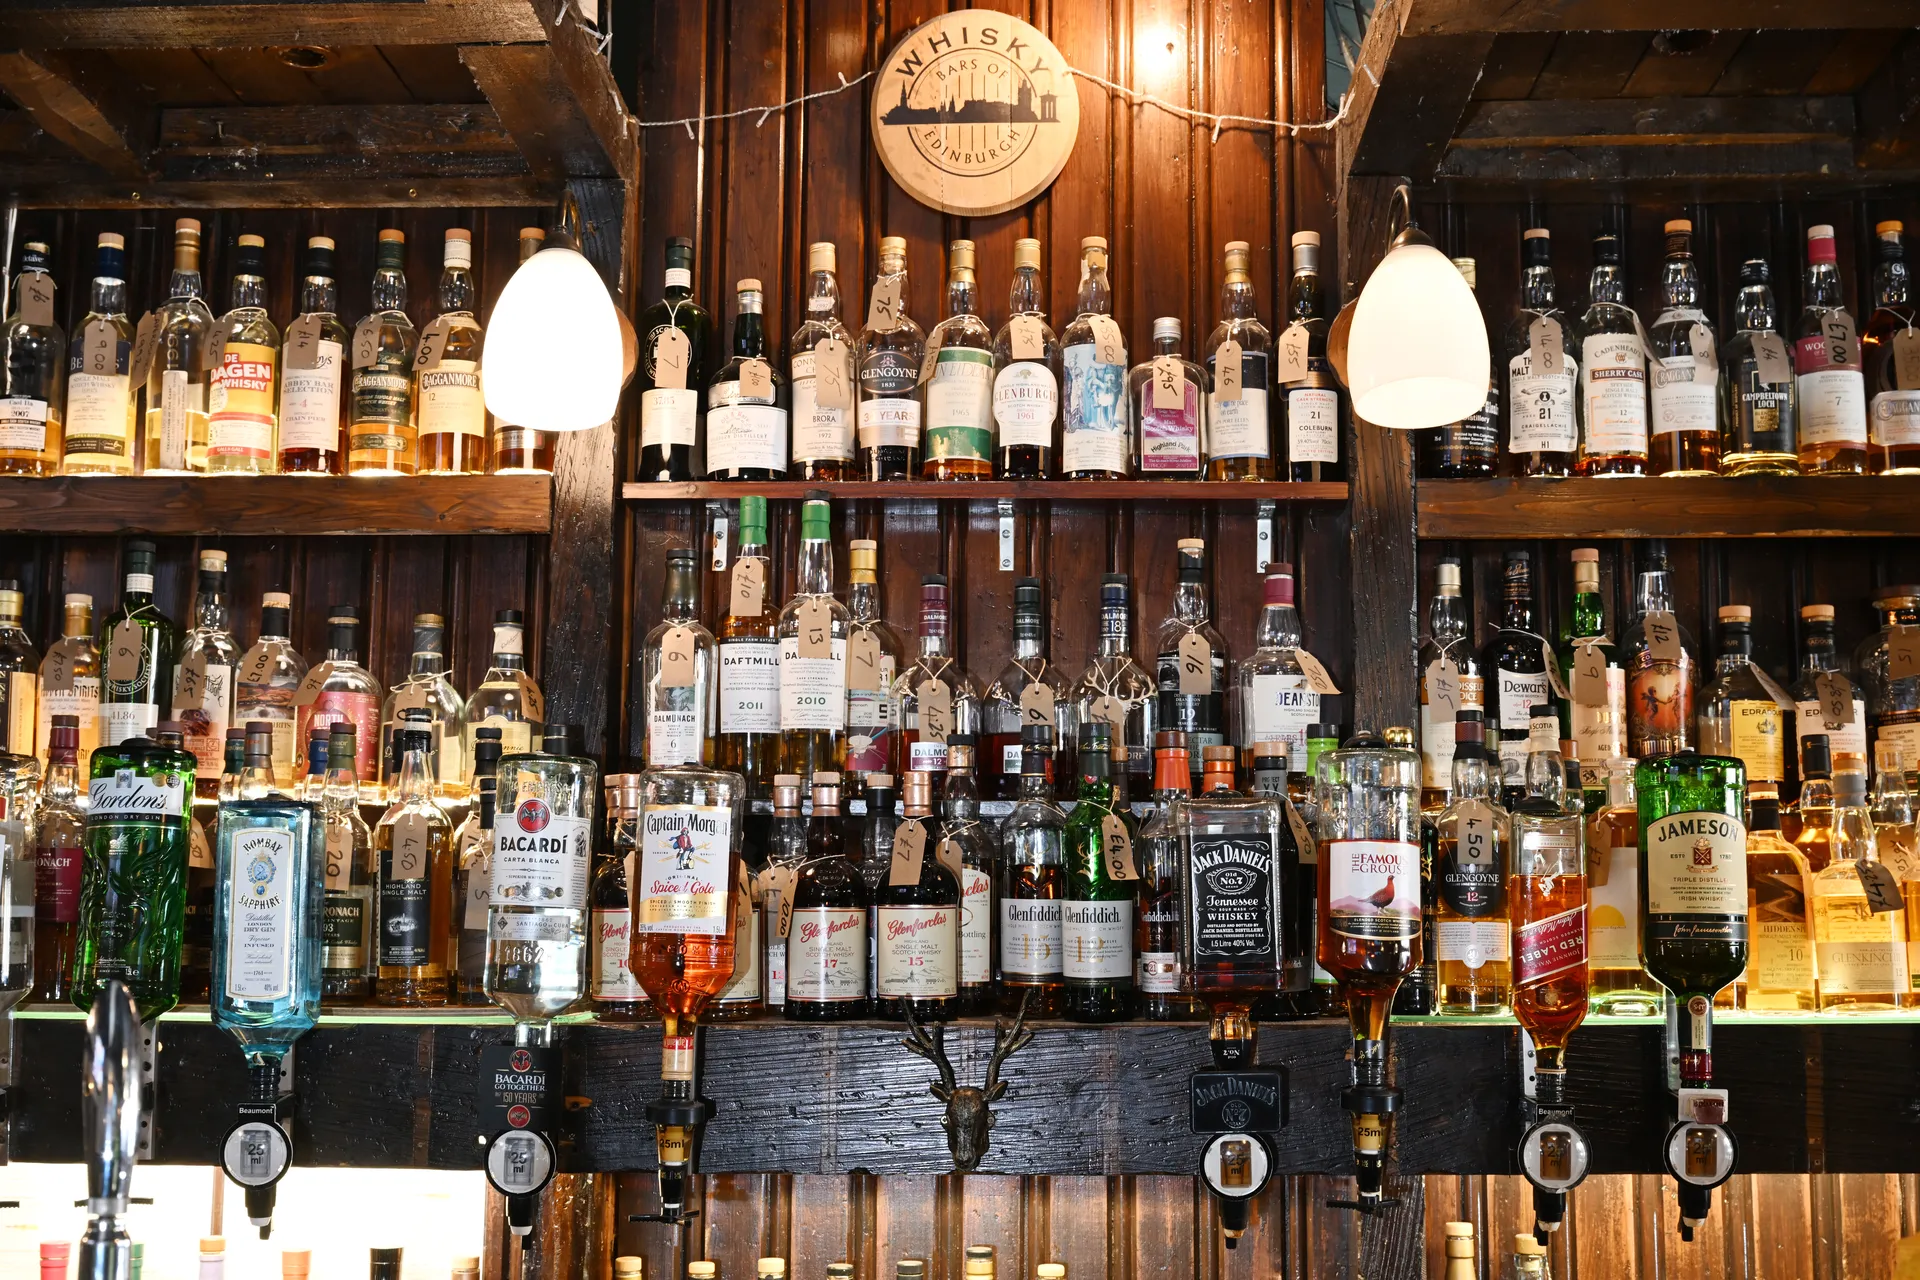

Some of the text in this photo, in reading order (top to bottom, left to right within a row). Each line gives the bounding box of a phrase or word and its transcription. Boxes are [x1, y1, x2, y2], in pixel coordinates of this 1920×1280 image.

[896, 26, 1049, 77] WHISKY
[936, 59, 1009, 82] BARS OF
[924, 130, 1021, 164] EDINBURGH
[876, 296, 892, 321] 75
[417, 333, 440, 366] 4.00
[225, 353, 239, 364] DE
[663, 355, 679, 369] 7
[861, 367, 918, 380] GLENGOYNE
[1222, 366, 1236, 387] 46
[1511, 366, 1529, 377] MALT
[1594, 370, 1626, 378] SHERRY
[223, 378, 267, 390] WHISKY
[284, 380, 334, 390] ABBEY BAR
[824, 364, 843, 397] 75
[283, 386, 334, 394] SELECTION
[995, 387, 1057, 402] GLENBURGIE
[428, 393, 436, 401] 12
[1742, 391, 1788, 402] CAMPBELTOWN
[1758, 400, 1775, 408] LOCH
[11, 410, 29, 418] 2007
[880, 410, 915, 422] YEARS
[952, 408, 970, 416] 1965
[1016, 411, 1035, 420] 1961
[1311, 411, 1321, 420] 21
[1539, 408, 1551, 419] 21
[812, 414, 837, 423] BRORA
[1150, 440, 1191, 453] Highland Park
[1110, 621, 1122, 632] 18
[809, 627, 824, 645] 13
[724, 657, 780, 666] DAFTMILL
[856, 654, 873, 668] 7
[1186, 655, 1205, 674] 16
[134, 666, 152, 691] SOCIETY
[1504, 681, 1546, 694] Dewar's
[739, 701, 763, 710] 2011
[797, 696, 826, 705] 2010
[1522, 700, 1531, 709] 12
[110, 711, 135, 720] 41.86
[1180, 708, 1196, 721] 19
[1742, 708, 1782, 716] EDRADOUR
[314, 714, 343, 726] NORTH
[654, 714, 696, 723] DALMUNACH
[670, 739, 677, 749] 6
[89, 782, 167, 811] Gordon's
[647, 813, 684, 835] Captain
[1658, 819, 1739, 842] JAMESON
[243, 838, 283, 855] BOMBAY
[501, 835, 568, 854] BACARDÍ
[326, 849, 344, 878] 20
[1192, 844, 1272, 874] JACK DANIEL'S
[1352, 853, 1360, 873] THE
[1221, 877, 1243, 885] No.7
[1446, 873, 1499, 883] GLENGOYNE
[650, 880, 688, 894] Spiced
[238, 894, 280, 910] SAPPHIRE
[1206, 895, 1259, 906] Tennessee
[1467, 892, 1478, 902] 12
[245, 913, 274, 922] Distilled
[1065, 906, 1120, 924] Glenfiddich
[888, 912, 946, 941] Glenfarclas
[1763, 925, 1791, 933] HIDDEN
[505, 944, 544, 963] 1862
[1075, 936, 1105, 963] 12
[1520, 936, 1584, 963] RED LABEL
[1789, 949, 1803, 962] 10
[823, 959, 838, 968] 17
[908, 957, 924, 966] 15
[495, 1073, 546, 1085] BACARDÍ
[503, 1092, 537, 1103] 150 YEARS
[1196, 1077, 1278, 1107] JACK DANIEL'S
[1358, 1127, 1384, 1137] 25ml
[248, 1144, 264, 1155] 25
[659, 1138, 685, 1149] 25ml
[511, 1152, 527, 1164] 25
[1228, 1154, 1244, 1166] 25
[513, 1165, 524, 1173] ml
